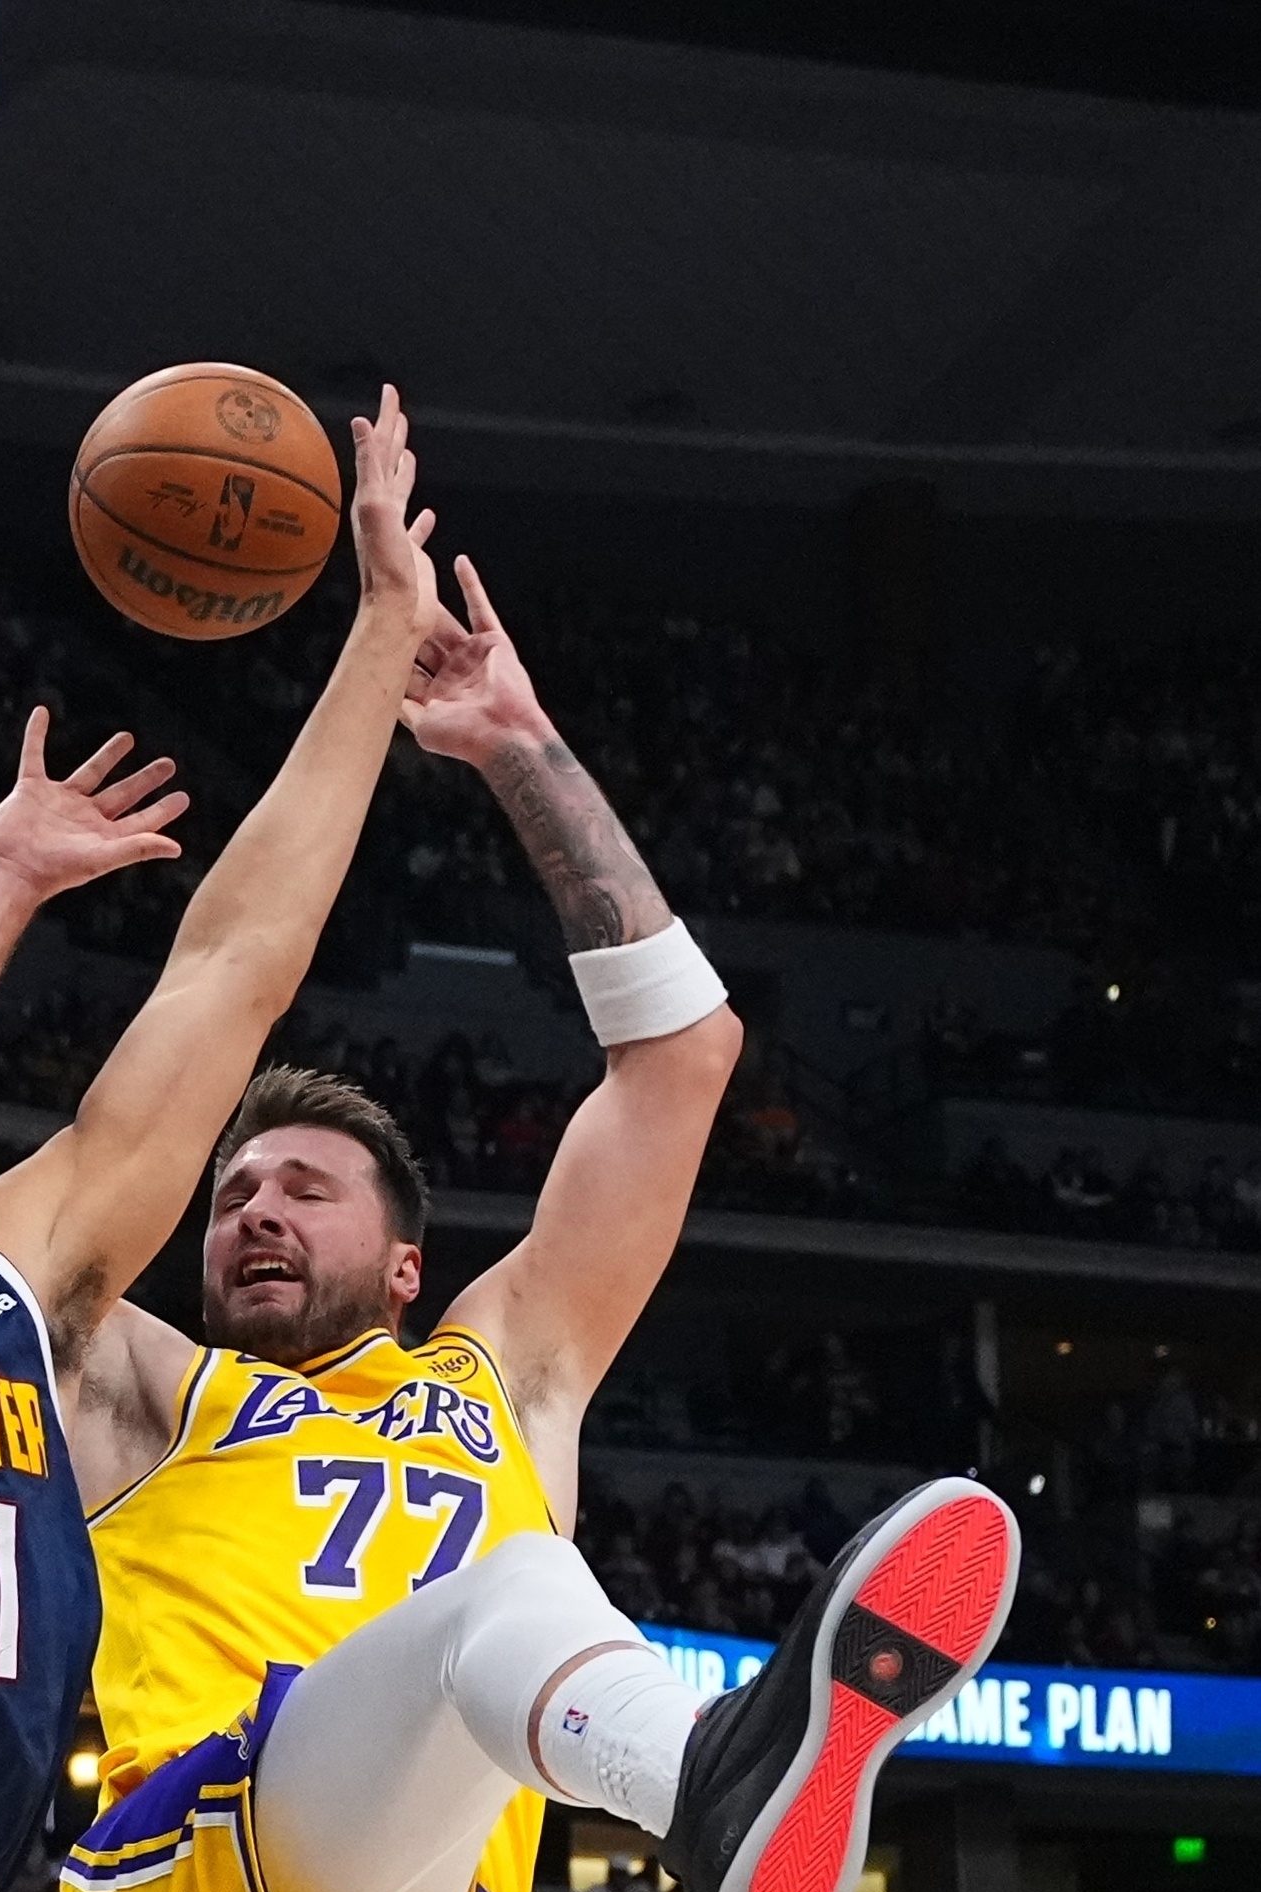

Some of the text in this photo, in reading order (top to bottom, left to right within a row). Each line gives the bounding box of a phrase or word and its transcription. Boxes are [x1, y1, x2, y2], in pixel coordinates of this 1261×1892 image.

[118, 547, 285, 624] Wilson
[293, 1455, 490, 1600] 77
[649, 1641, 726, 1697] UR
[904, 1678, 1033, 1748] AME
[1047, 1682, 1172, 1756] PLAN
